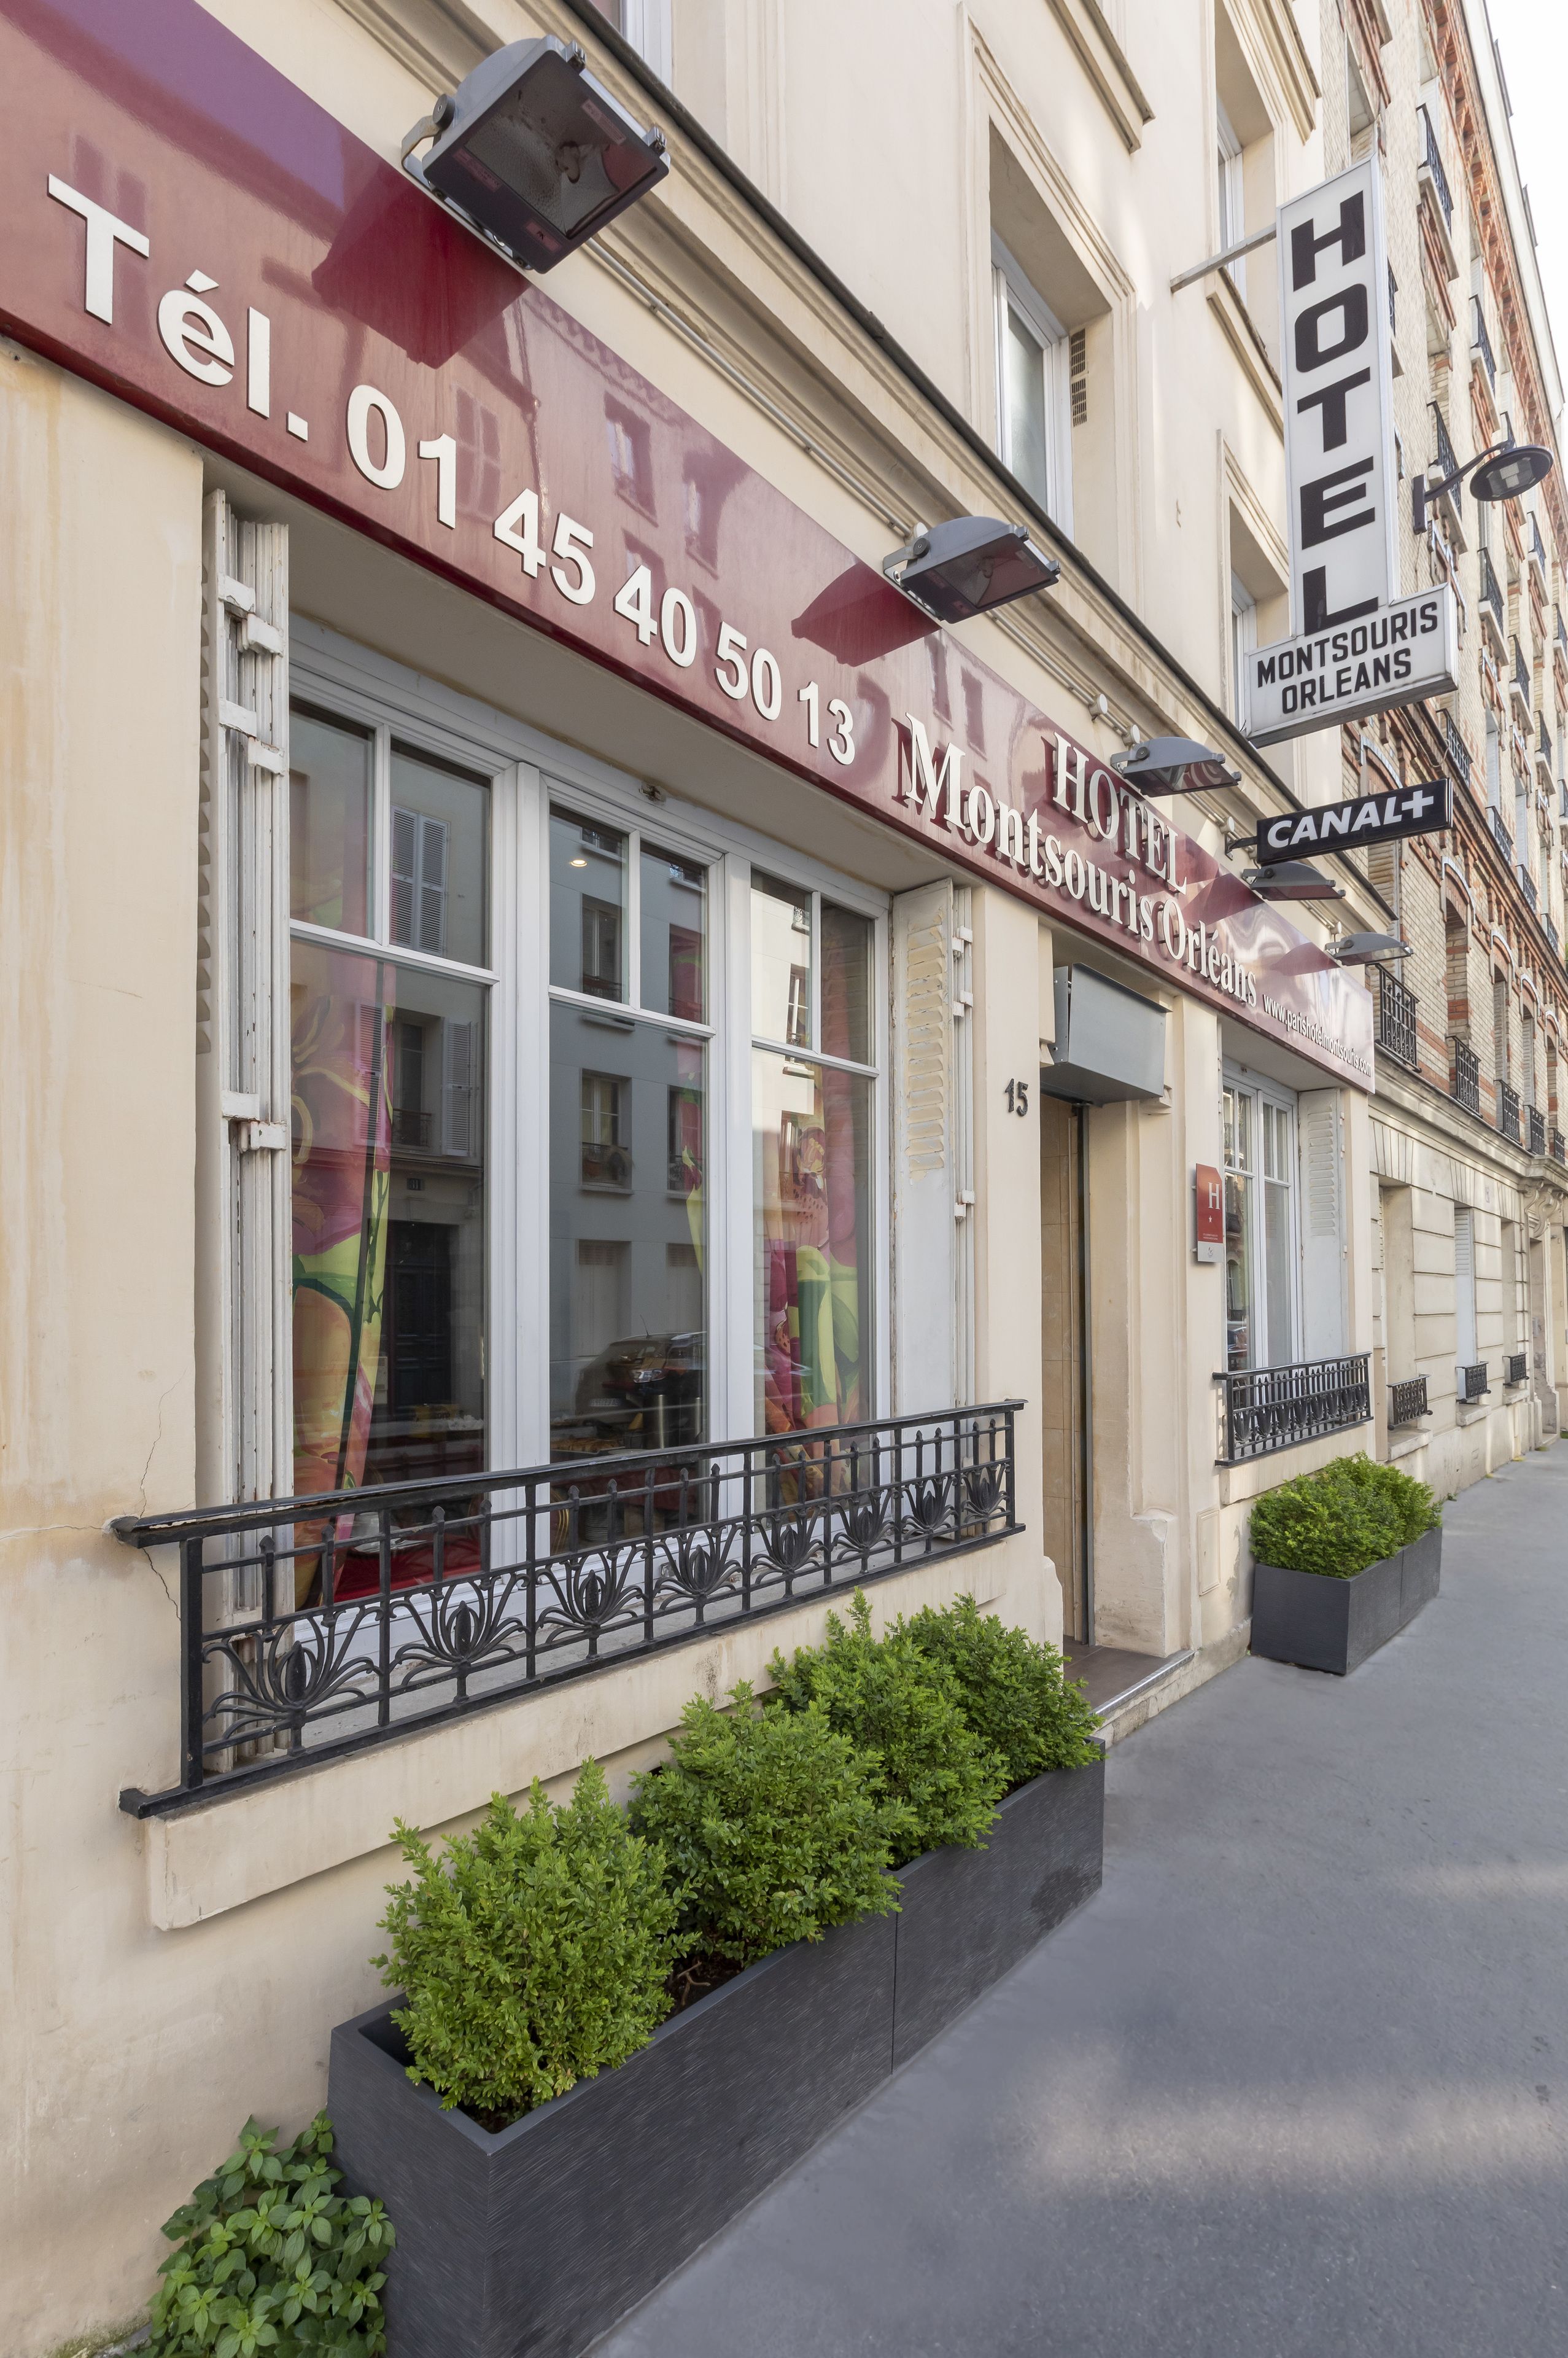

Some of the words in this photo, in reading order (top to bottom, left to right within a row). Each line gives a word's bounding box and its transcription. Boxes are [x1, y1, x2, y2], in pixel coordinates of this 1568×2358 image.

[1290, 190, 1379, 637] HOTEL
[48, 173, 308, 442] Tél.
[346, 384, 456, 529] 01
[494, 488, 596, 605] 45
[614, 565, 696, 667] 40
[715, 621, 782, 720] 50
[798, 681, 855, 765] 13
[1257, 601, 1438, 688] MONTSOURIS
[1282, 648, 1411, 714] ORLEANS
[1052, 731, 1187, 895] HOTEL
[1267, 790, 1434, 849] CANAL+
[905, 712, 1153, 941] Montsouris
[1163, 899, 1257, 1008] Orléans
[1263, 994, 1372, 1078] www.parishotelmontsouris.com
[1004, 1078, 1028, 1116] 15
[1208, 1181, 1221, 1210] H
